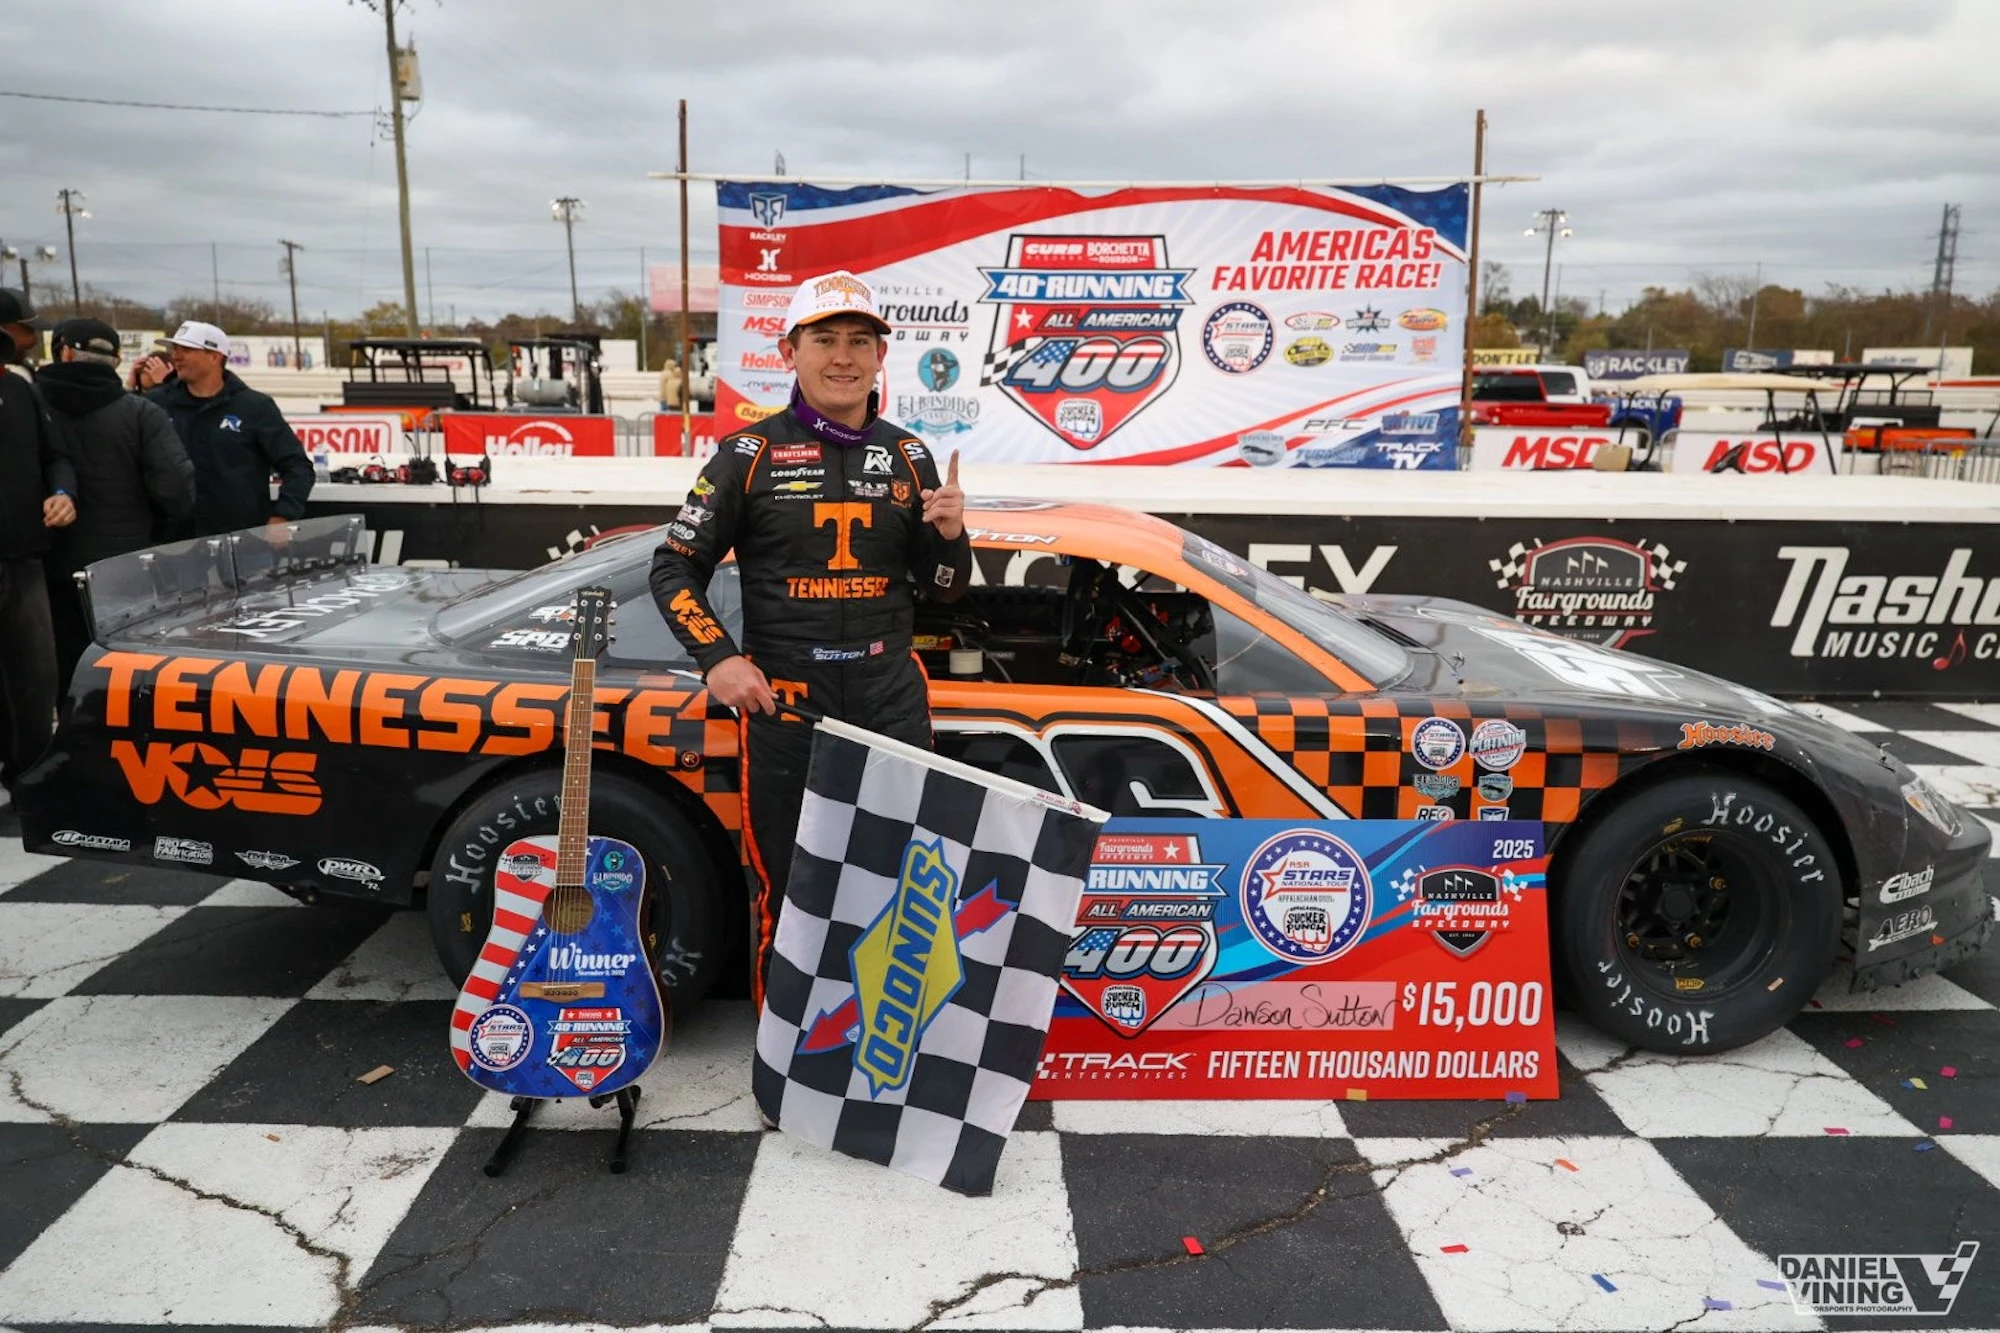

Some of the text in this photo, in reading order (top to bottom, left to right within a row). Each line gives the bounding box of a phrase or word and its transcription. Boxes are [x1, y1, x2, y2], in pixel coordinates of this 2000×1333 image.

[750, 232, 786, 242] RACKLEY
[1025, 242, 1150, 257] CURB BORCHETTA
[1251, 229, 1434, 262] AMERICA'S
[744, 273, 792, 282] HOOSIER
[1212, 263, 1441, 291] FAVORITE RACE!
[1046, 275, 1175, 298] RUNNING
[1044, 313, 1176, 328] ALL AMERICAN
[1004, 336, 1172, 393] 400
[1473, 353, 1512, 364] DON'T
[1609, 357, 1688, 373] RACKLEY
[1304, 419, 1368, 430] PFC
[773, 449, 819, 458] CRAFTSMAN
[1375, 442, 1444, 453] TRACK
[1393, 453, 1427, 469] TV
[1702, 441, 1815, 473] MSD
[770, 467, 826, 478] GOODYEAR
[966, 530, 1057, 545] TTON
[786, 576, 889, 599] TENNESSEE
[1541, 576, 1634, 587] NASHVILLE
[1515, 585, 1654, 616] Fairgrounds
[1515, 615, 1653, 627] SPEEDWAY
[1821, 632, 1939, 659] MUSIC
[815, 650, 866, 660] SUTTON
[92, 652, 692, 767] TENNESSEE
[1470, 729, 1526, 754] PLATINUM
[1678, 721, 1776, 751] Hoosier
[157, 838, 179, 848] PRO
[1700, 792, 1825, 882] Hoosier
[1099, 842, 1153, 854] Fairgrounds
[1493, 839, 1535, 859] 2025
[323, 859, 371, 874] PWR
[1088, 869, 1209, 890] RUNNING
[1283, 870, 1351, 881] STARS
[1880, 864, 1935, 894] Eibach
[1428, 892, 1493, 900] NASHVILLE
[1088, 904, 1212, 917] ALL AMERICAN
[1287, 912, 1327, 924] SUCKER
[1411, 899, 1510, 921] Fairgrounds
[1286, 923, 1326, 935] PUNCH
[1411, 920, 1510, 928] SPEEDWAY
[1875, 905, 1932, 939] AERO
[550, 942, 637, 970] Winner
[1064, 926, 1208, 979] 400
[867, 850, 949, 1076] SUNOCO
[1105, 991, 1141, 1002] SUCKER
[1598, 960, 1715, 1045] Hoosier
[1105, 1001, 1140, 1011] PUNCH
[1180, 983, 1401, 1030] Dawson Sutton
[1402, 981, 1543, 1033] $15,000
[573, 1022, 625, 1032] RUNNING
[558, 1046, 623, 1067] 400
[1057, 1052, 1190, 1070] TRACK
[1207, 1050, 1539, 1080] FIFTEEN THOUSAND DOLLARS
[1051, 1071, 1187, 1080] ENTERPRISES
